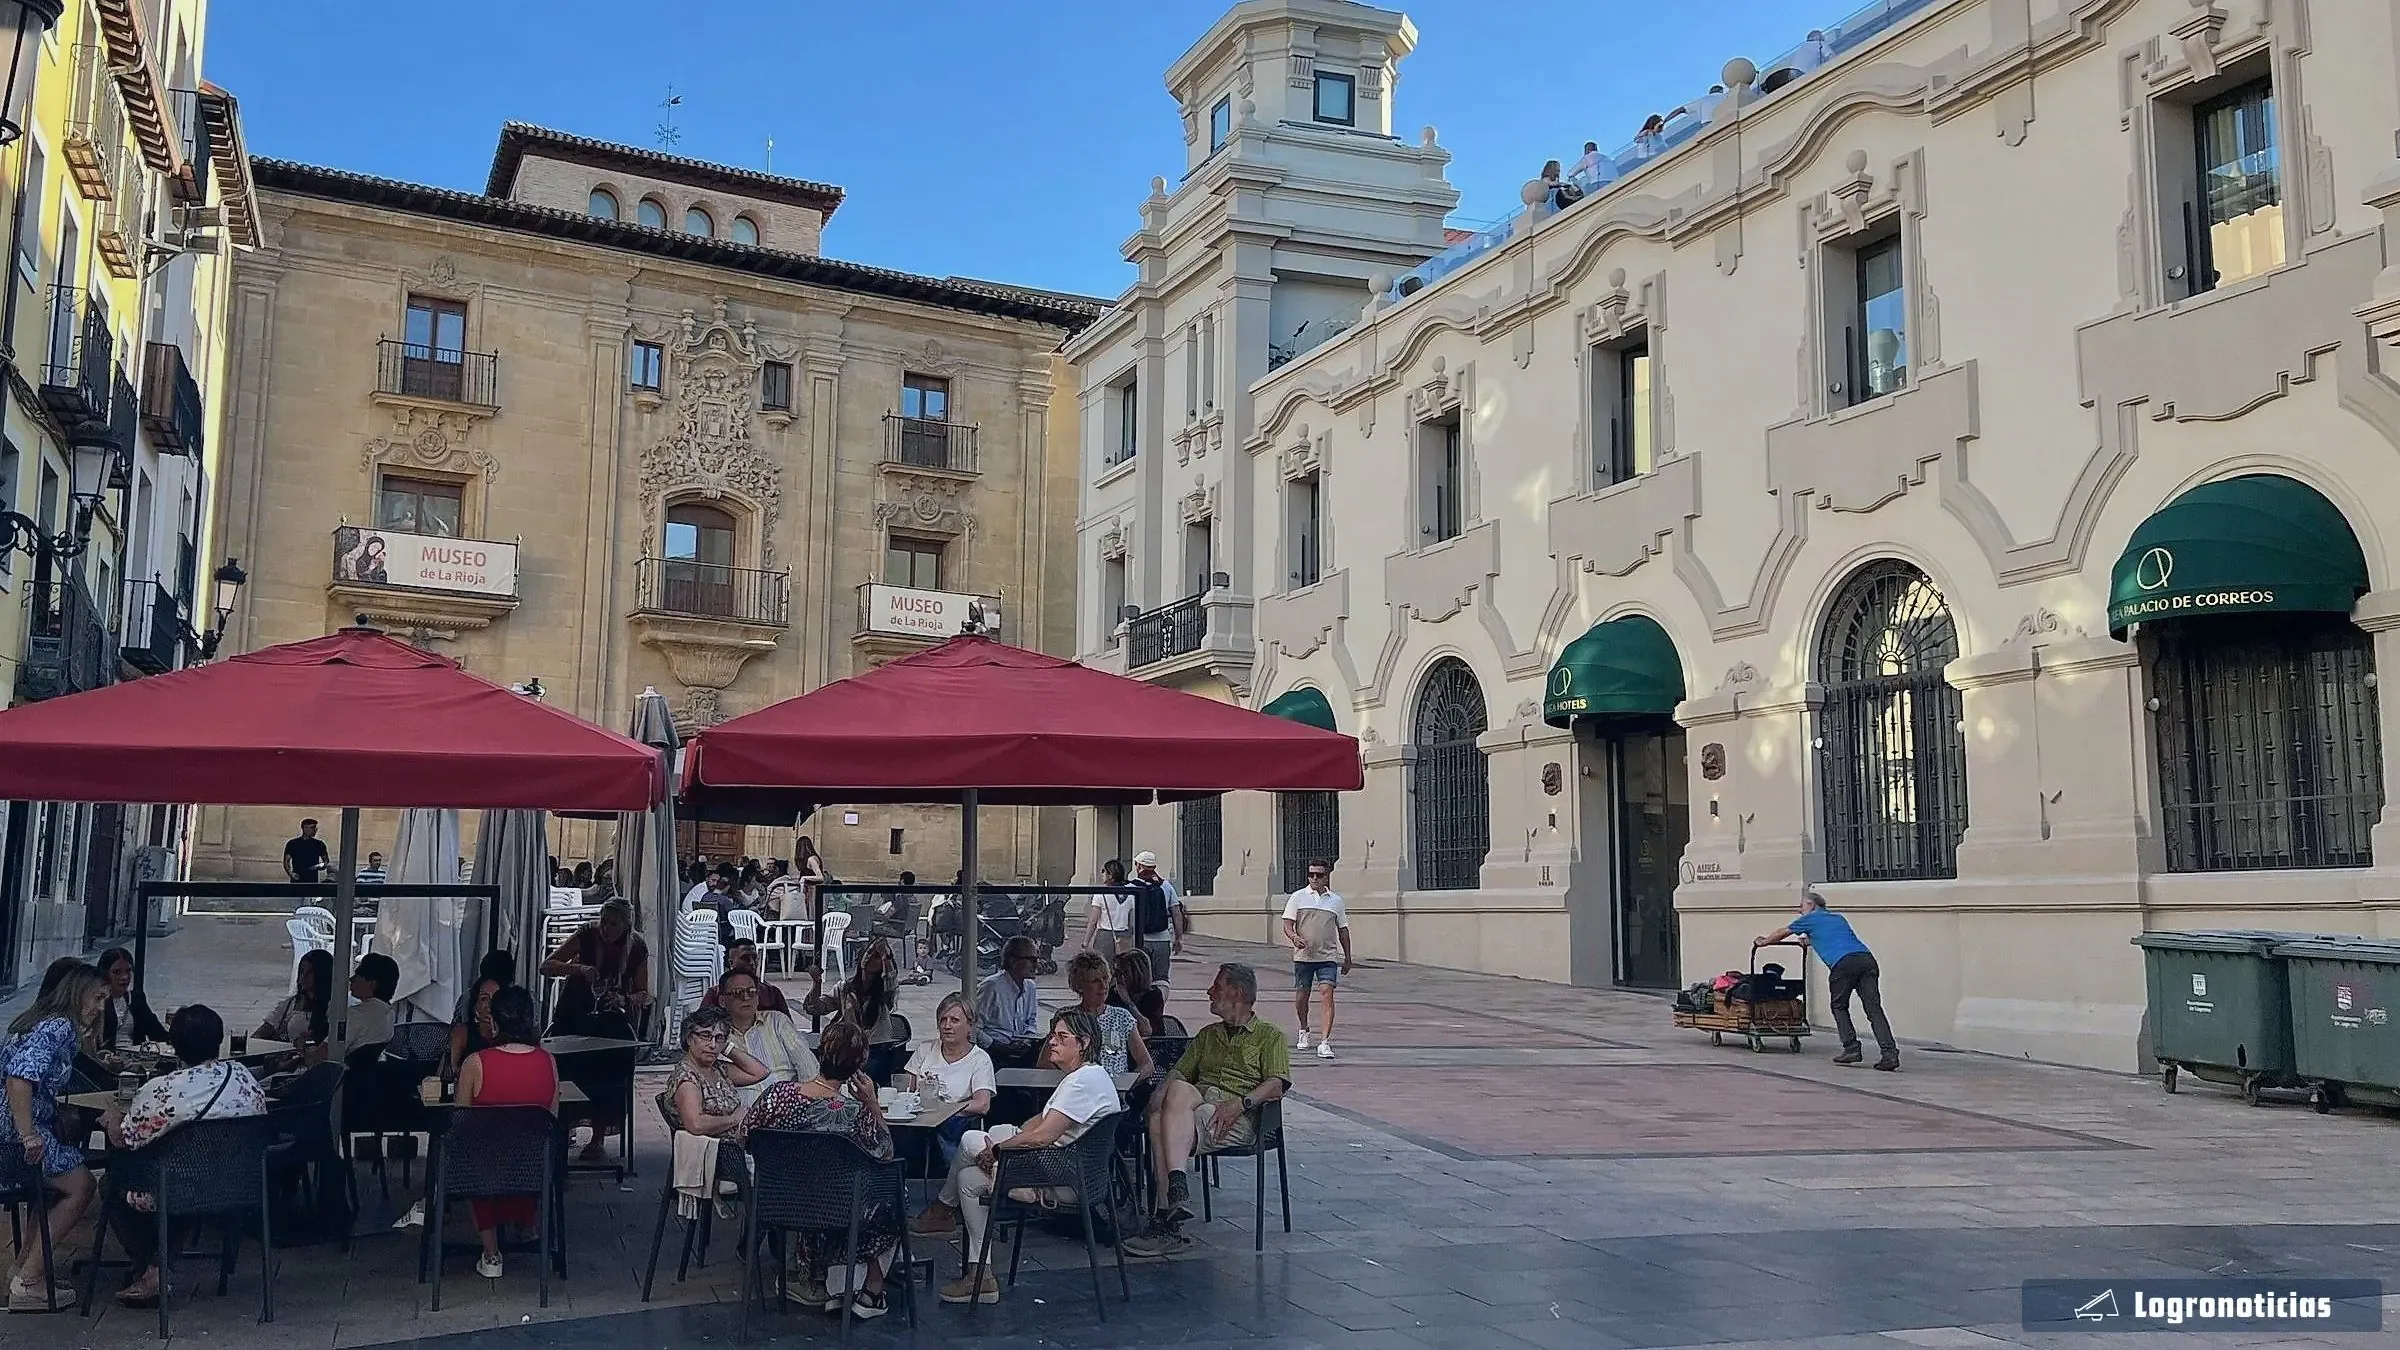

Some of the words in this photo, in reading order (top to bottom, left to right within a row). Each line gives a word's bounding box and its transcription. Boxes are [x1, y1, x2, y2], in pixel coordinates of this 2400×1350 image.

[422, 546, 487, 567] MUSEO
[420, 568, 436, 579] de
[439, 569, 452, 581] La
[455, 571, 486, 585] Rioja
[891, 595, 943, 615] MUSEO
[2123, 598, 2169, 617] PALACIO
[2172, 595, 2192, 609] DE
[2195, 591, 2274, 607] CORREOS
[890, 615, 903, 626] de
[905, 616, 916, 627] La
[918, 618, 943, 631] Rioja
[1557, 698, 1587, 711] HOTELS
